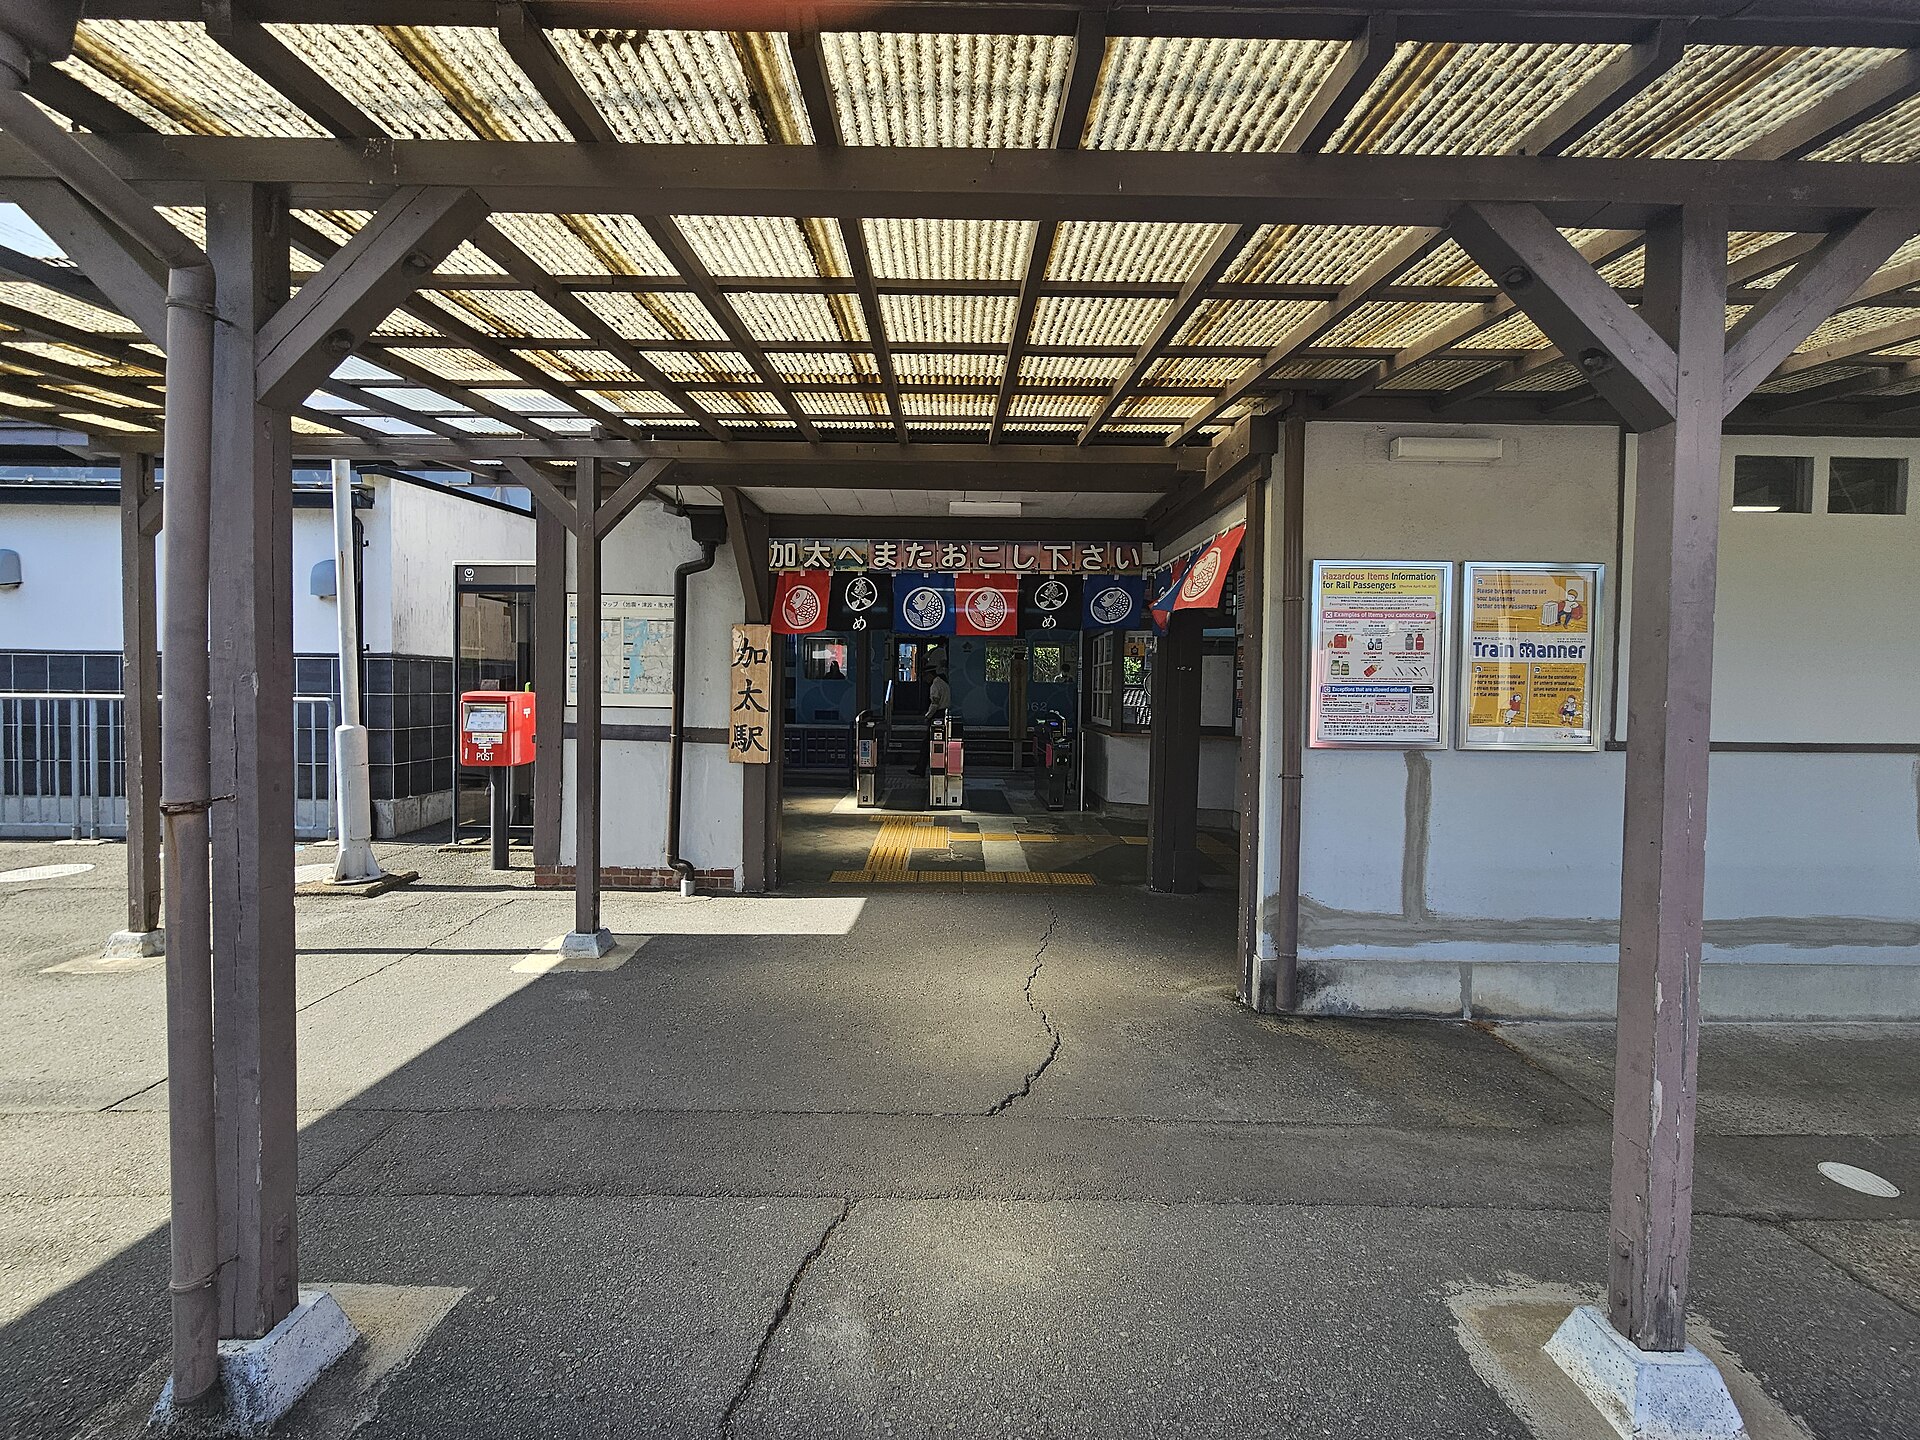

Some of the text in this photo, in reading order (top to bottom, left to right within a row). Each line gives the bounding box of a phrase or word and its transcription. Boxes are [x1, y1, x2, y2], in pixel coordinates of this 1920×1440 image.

[769, 541, 1140, 570] 加太へまたおこし下さい
[1367, 572, 1389, 580] Items
[1391, 572, 1436, 581] Information
[1322, 581, 1396, 591] for Rail Passengers
[853, 615, 867, 631] め
[1042, 614, 1057, 629] め
[1473, 641, 1586, 658] Train Manner
[731, 637, 768, 753] 加太駅
[476, 752, 494, 761] POST
